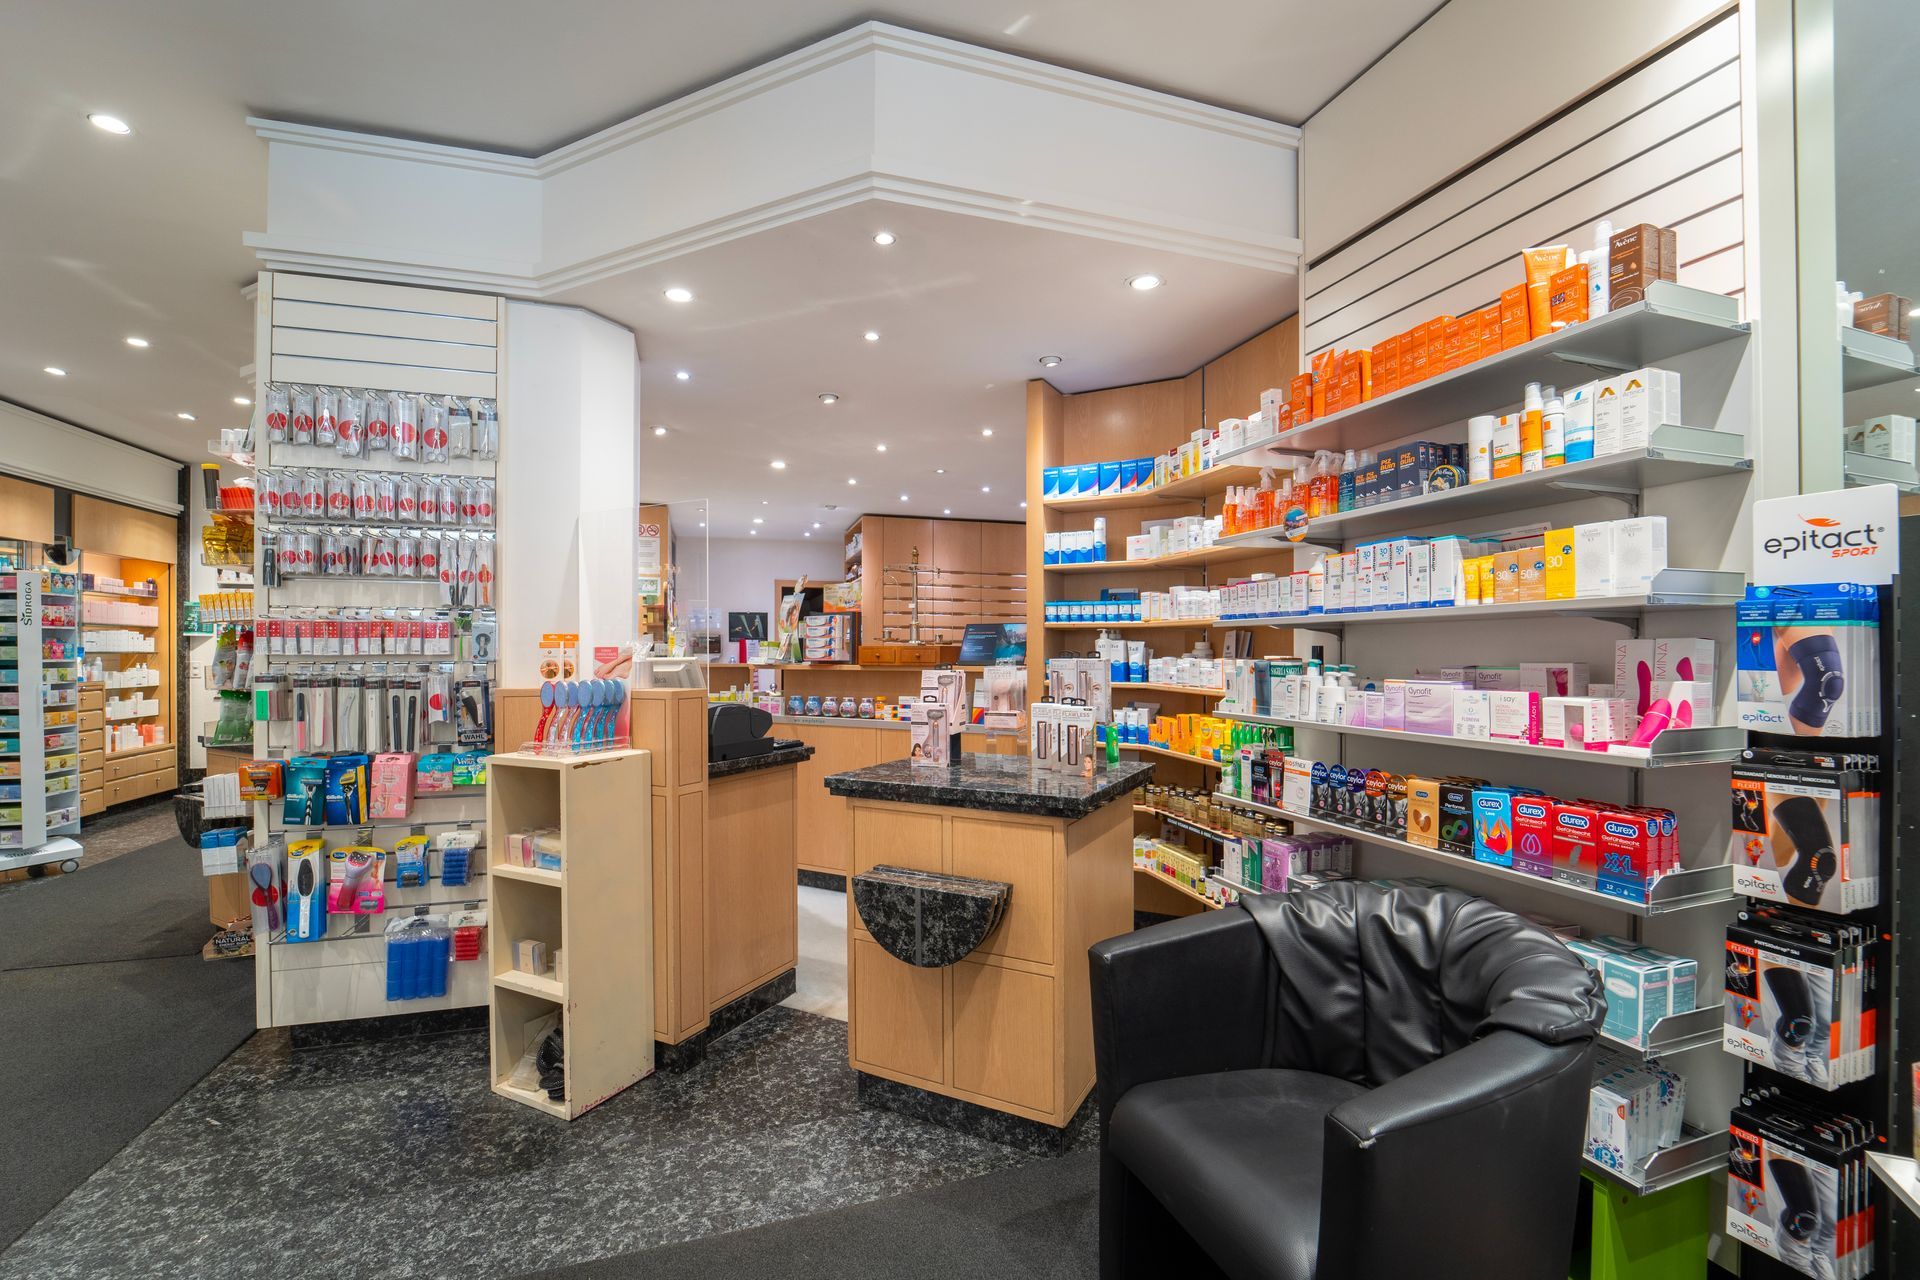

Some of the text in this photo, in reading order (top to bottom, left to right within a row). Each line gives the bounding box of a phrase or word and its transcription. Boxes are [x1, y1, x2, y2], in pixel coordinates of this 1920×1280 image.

[1615, 236, 1637, 248] Avène
[1831, 547, 1879, 558] SPORT
[23, 581, 33, 626] SIDROGA
[1408, 686, 1432, 697] Gynofit
[1479, 799, 1501, 808] durex
[1519, 806, 1543, 817] durex
[1561, 814, 1586, 827] durex
[1606, 823, 1635, 837] durex
[1604, 852, 1639, 876] XXL
[215, 936, 250, 945] NATURAL
